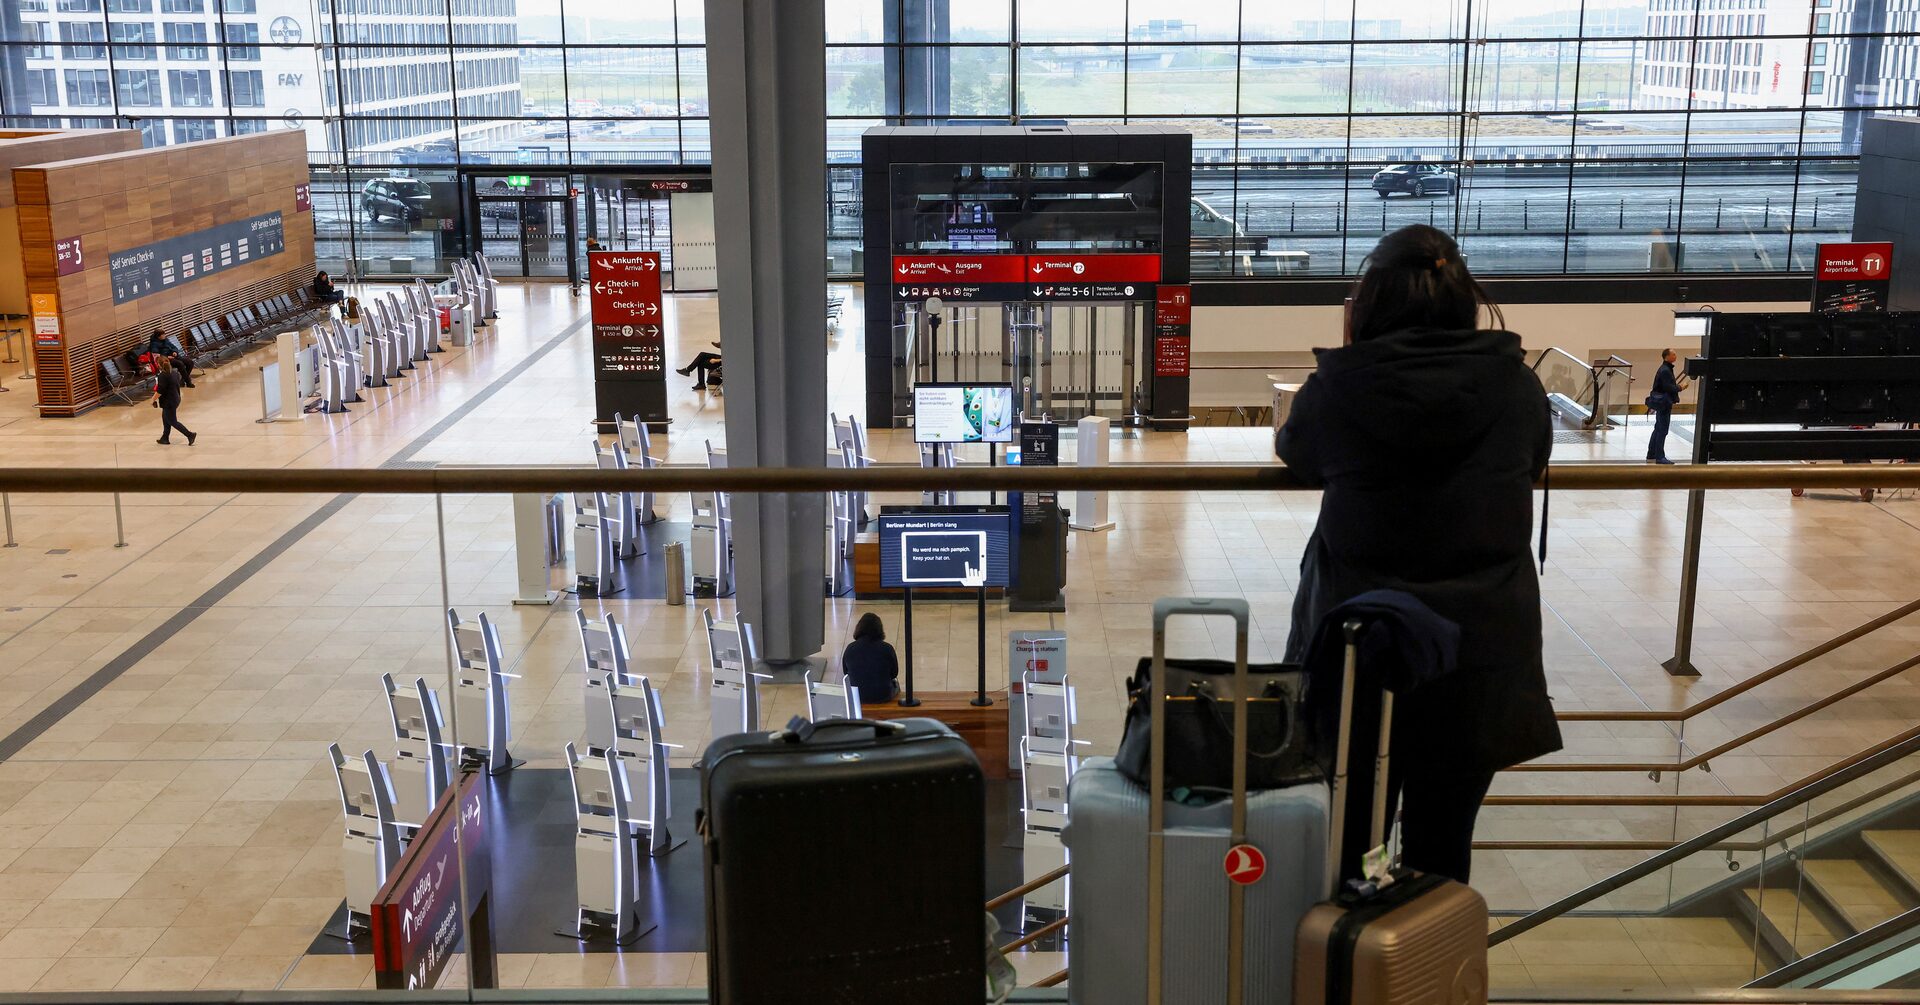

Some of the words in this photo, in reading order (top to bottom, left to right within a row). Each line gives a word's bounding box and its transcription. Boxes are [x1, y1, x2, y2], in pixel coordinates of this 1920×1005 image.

[278, 74, 302, 86] FAY
[305, 185, 310, 204] 3
[258, 218, 268, 229] Service
[74, 240, 82, 265] 3
[112, 257, 120, 270] Self
[121, 254, 136, 267] Service
[136, 249, 154, 263] Check-in
[1865, 259, 1880, 270] T1
[412, 872, 431, 912] Abflug
[414, 891, 435, 932] Departure
